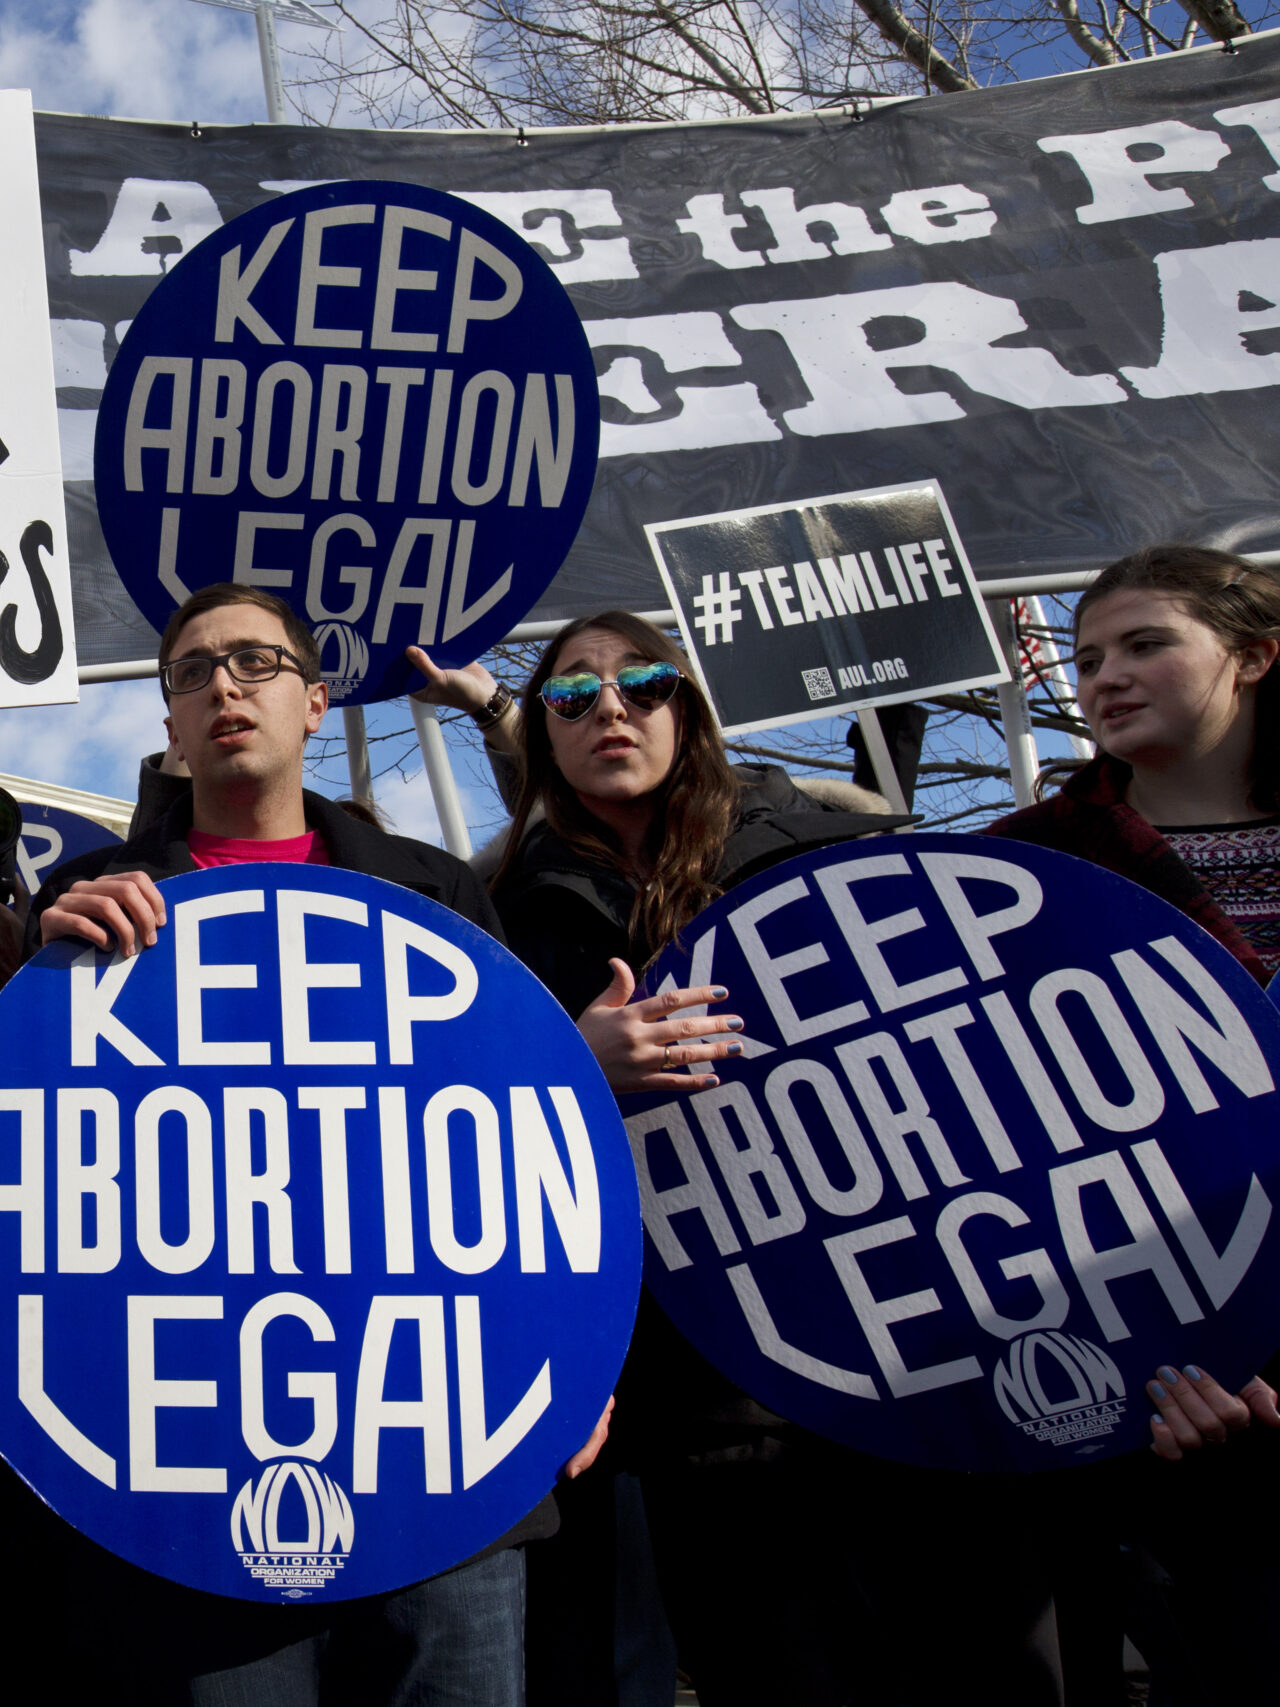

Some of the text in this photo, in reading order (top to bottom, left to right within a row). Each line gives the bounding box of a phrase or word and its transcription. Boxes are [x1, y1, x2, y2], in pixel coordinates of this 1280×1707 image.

[675, 183, 998, 269] the
[215, 204, 523, 354] KEEP
[124, 355, 576, 508] ABORTION
[157, 508, 514, 645] LEGAL
[693, 538, 962, 646] #TEAMLIFE
[312, 623, 369, 679] OW
[838, 657, 909, 690] AUL.ORG
[71, 890, 479, 1067] KEEP
[622, 935, 1276, 1271] ABORTION
[726, 1139, 1273, 1400] LEGAL
[18, 1292, 551, 1494] LEGAL
[993, 1331, 1126, 1424] NOW
[1022, 1403, 1125, 1433] NATIONAL
[1035, 1414, 1120, 1440] ORGANIZATION
[1051, 1425, 1113, 1443] FOR WOMEN
[230, 1462, 355, 1553] NOW
[242, 1556, 345, 1566] NATIONAL
[250, 1568, 335, 1576] ORGANIZATION
